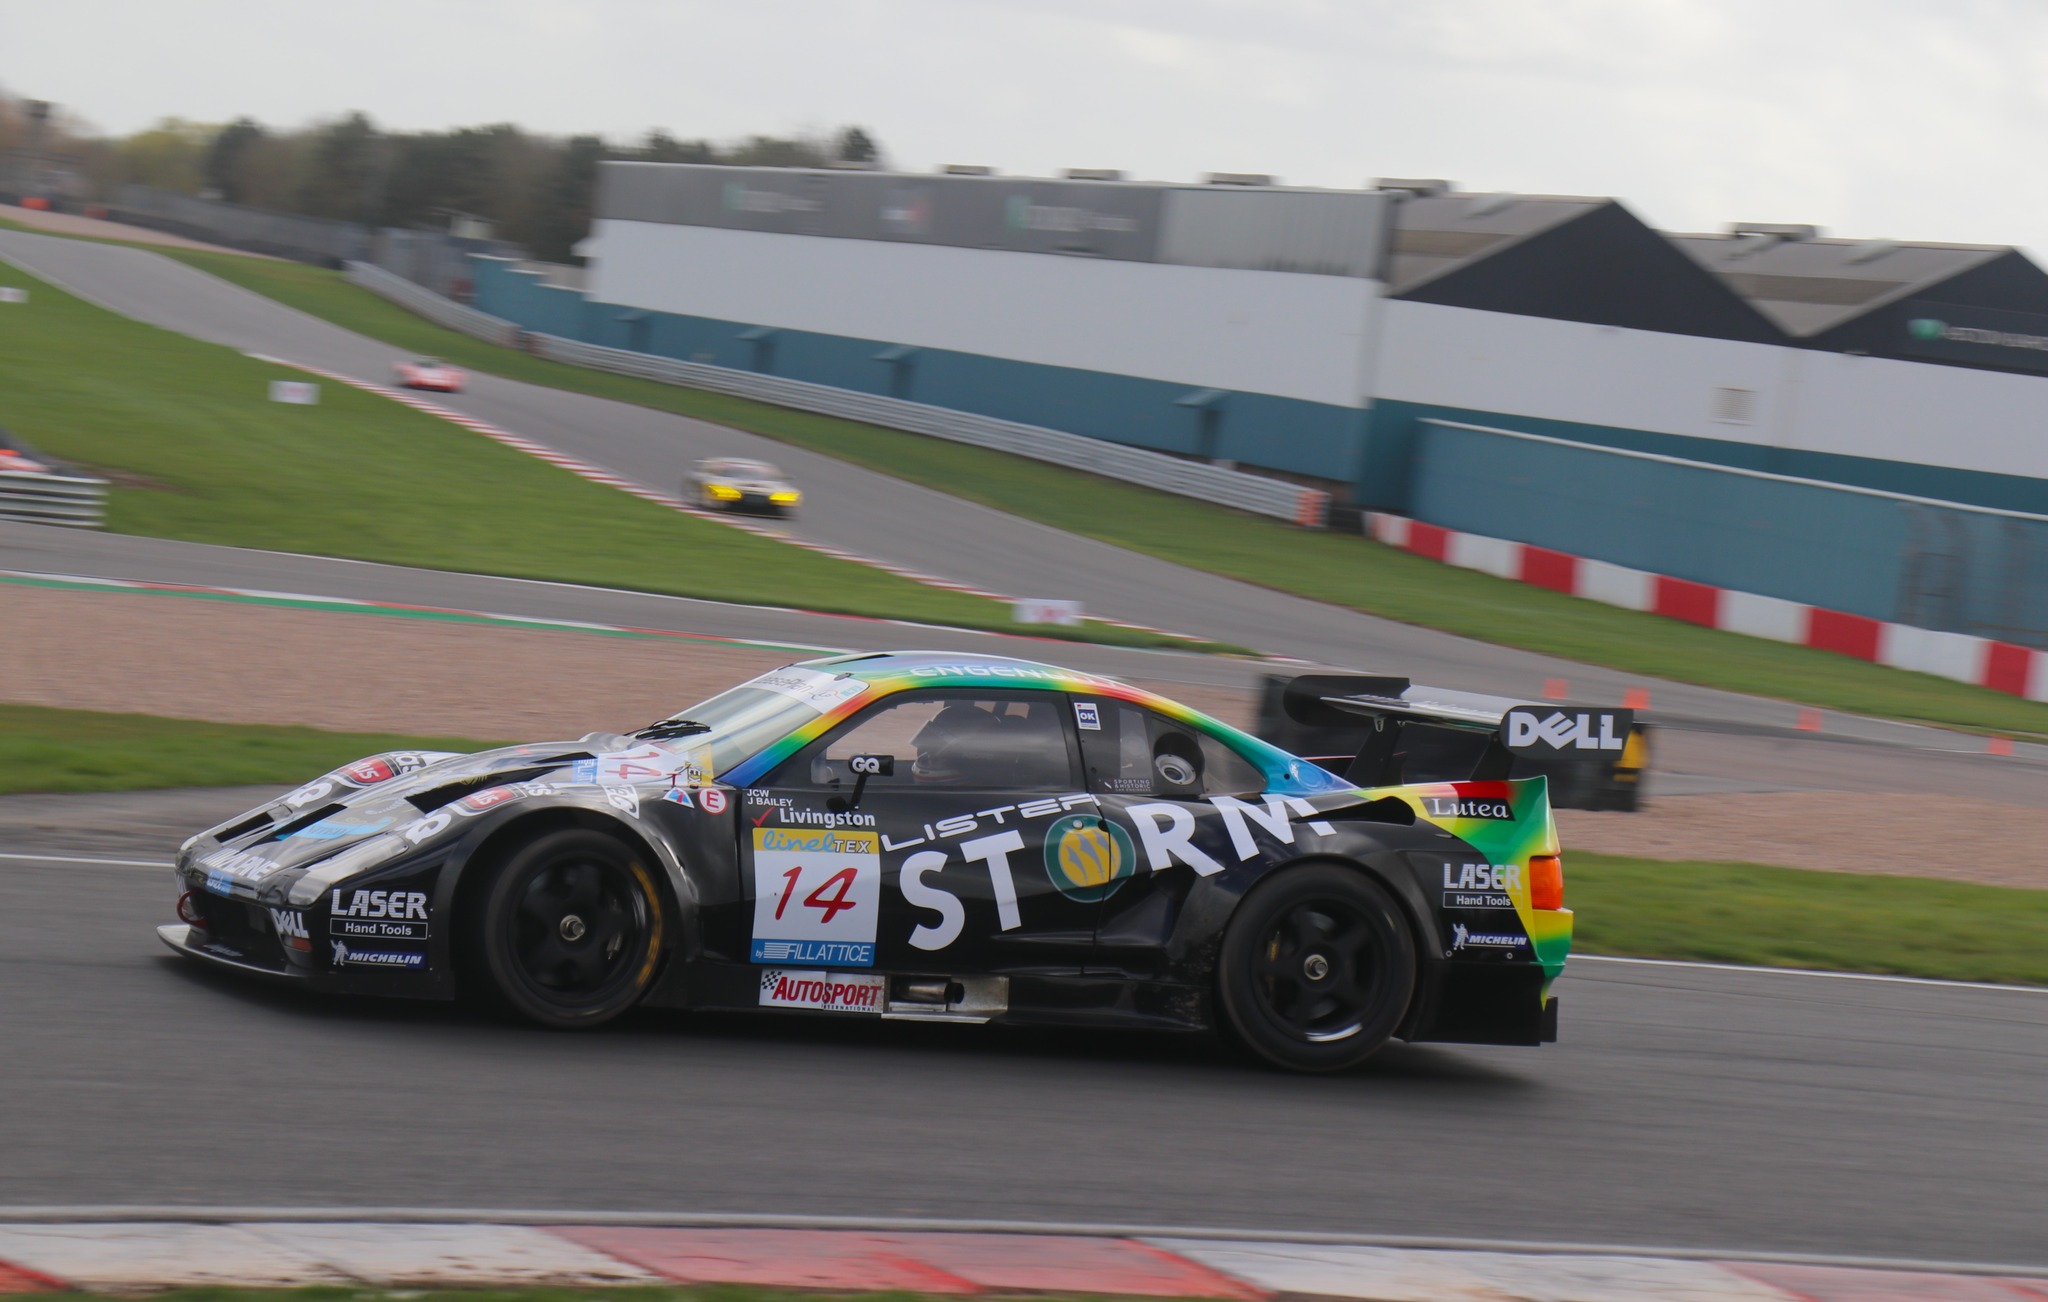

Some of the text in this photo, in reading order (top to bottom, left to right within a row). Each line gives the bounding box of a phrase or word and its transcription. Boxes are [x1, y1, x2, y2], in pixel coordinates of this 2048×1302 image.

[1080, 712, 1096, 721] OK
[1508, 711, 1623, 751] DELL
[852, 757, 881, 774] GQ
[706, 791, 719, 809] E
[747, 789, 769, 798] JCW
[756, 798, 793, 808] BAILEY
[1433, 798, 1510, 818] Lutea
[780, 808, 876, 828] Livingston
[1444, 863, 1523, 890] LASER
[774, 865, 859, 924] 14
[1456, 894, 1511, 907] Hand Tools
[331, 889, 428, 920] LASER
[270, 909, 310, 939] DELL
[345, 922, 412, 936] Hand Tools
[1468, 934, 1527, 946] MICHELIN
[348, 951, 423, 965] MICHELIN
[755, 943, 872, 962] by FILLATTICE
[772, 976, 883, 1007] AUTOSPORT
